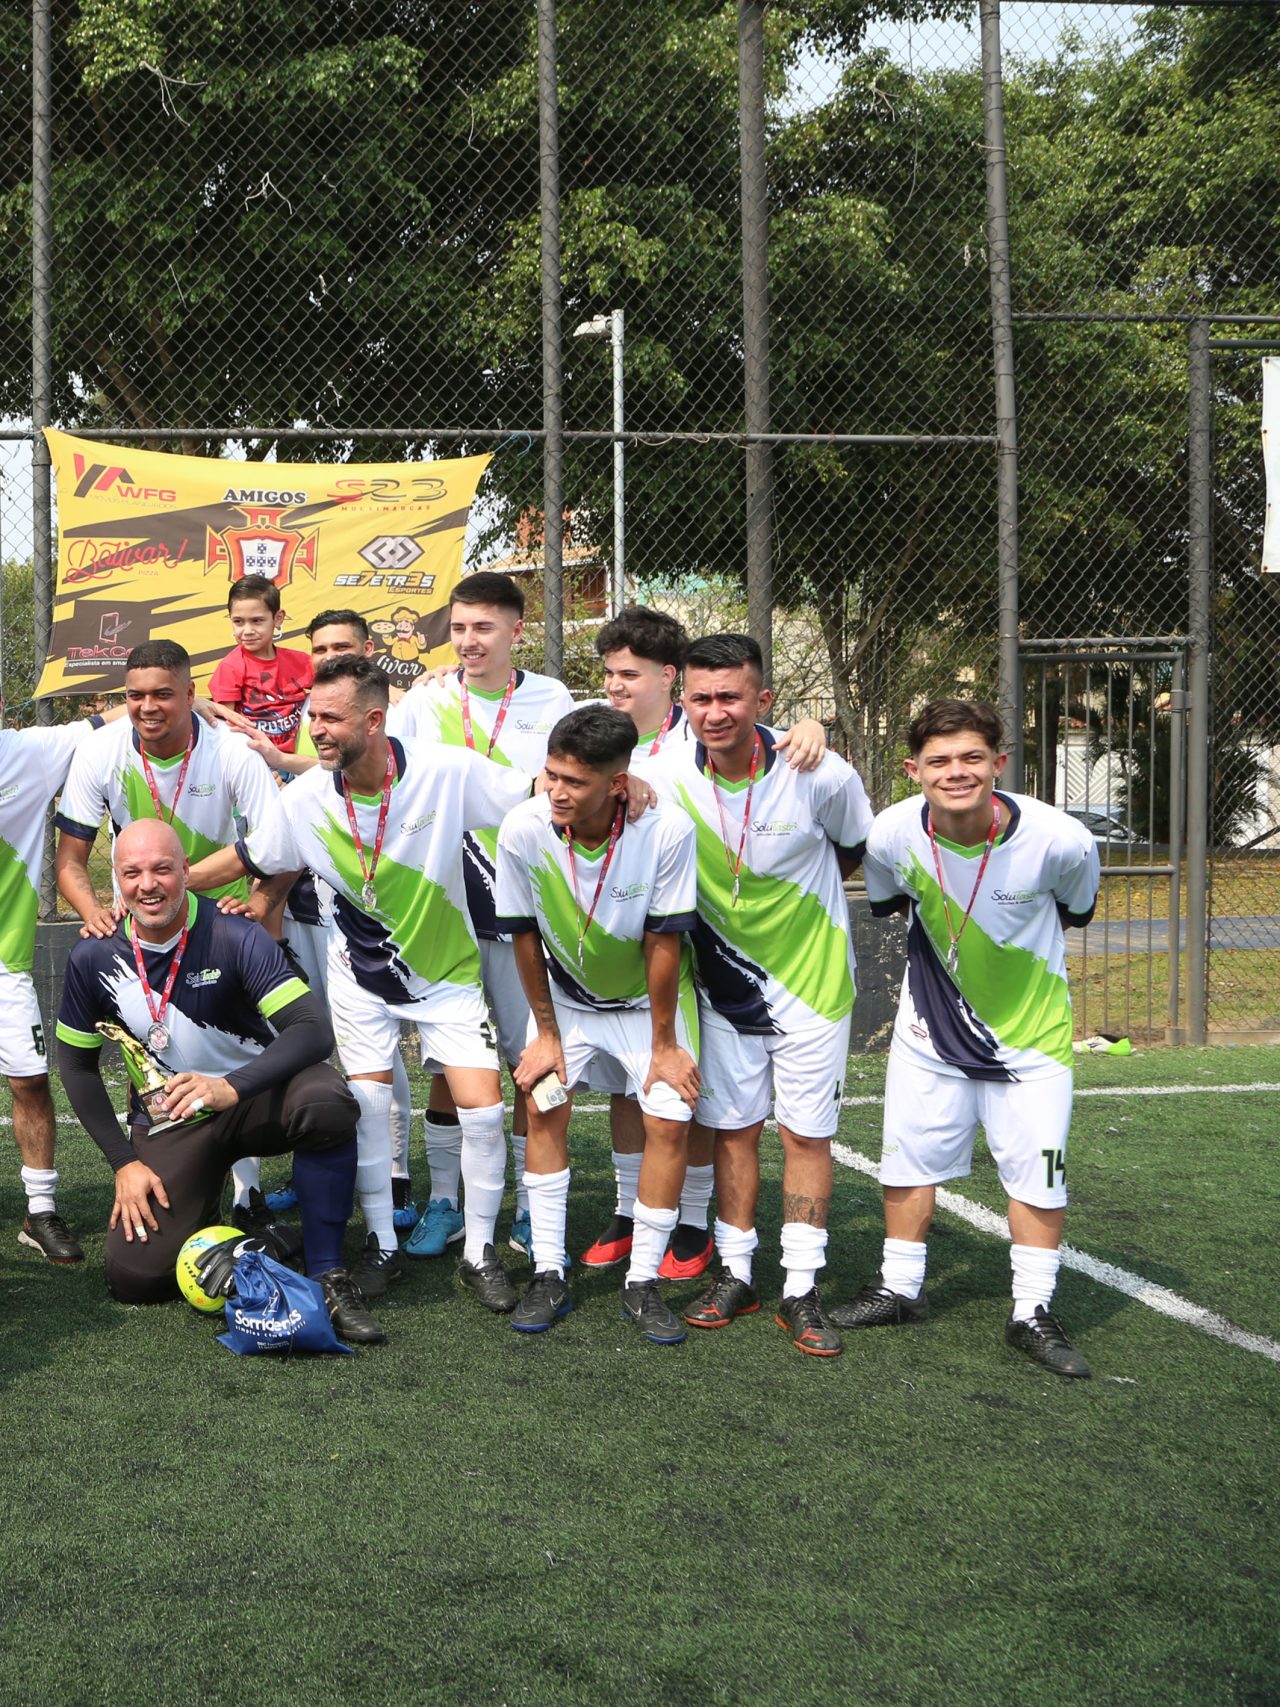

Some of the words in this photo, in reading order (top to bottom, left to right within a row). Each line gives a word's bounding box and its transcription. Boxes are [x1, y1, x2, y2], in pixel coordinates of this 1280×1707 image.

[116, 485, 176, 502] WFG
[223, 488, 307, 505] AMIGOS
[333, 571, 385, 587] SE7E
[386, 572, 437, 589] TR3S
[387, 587, 434, 595] ESPORTES
[1041, 1149, 1066, 1188] 14
